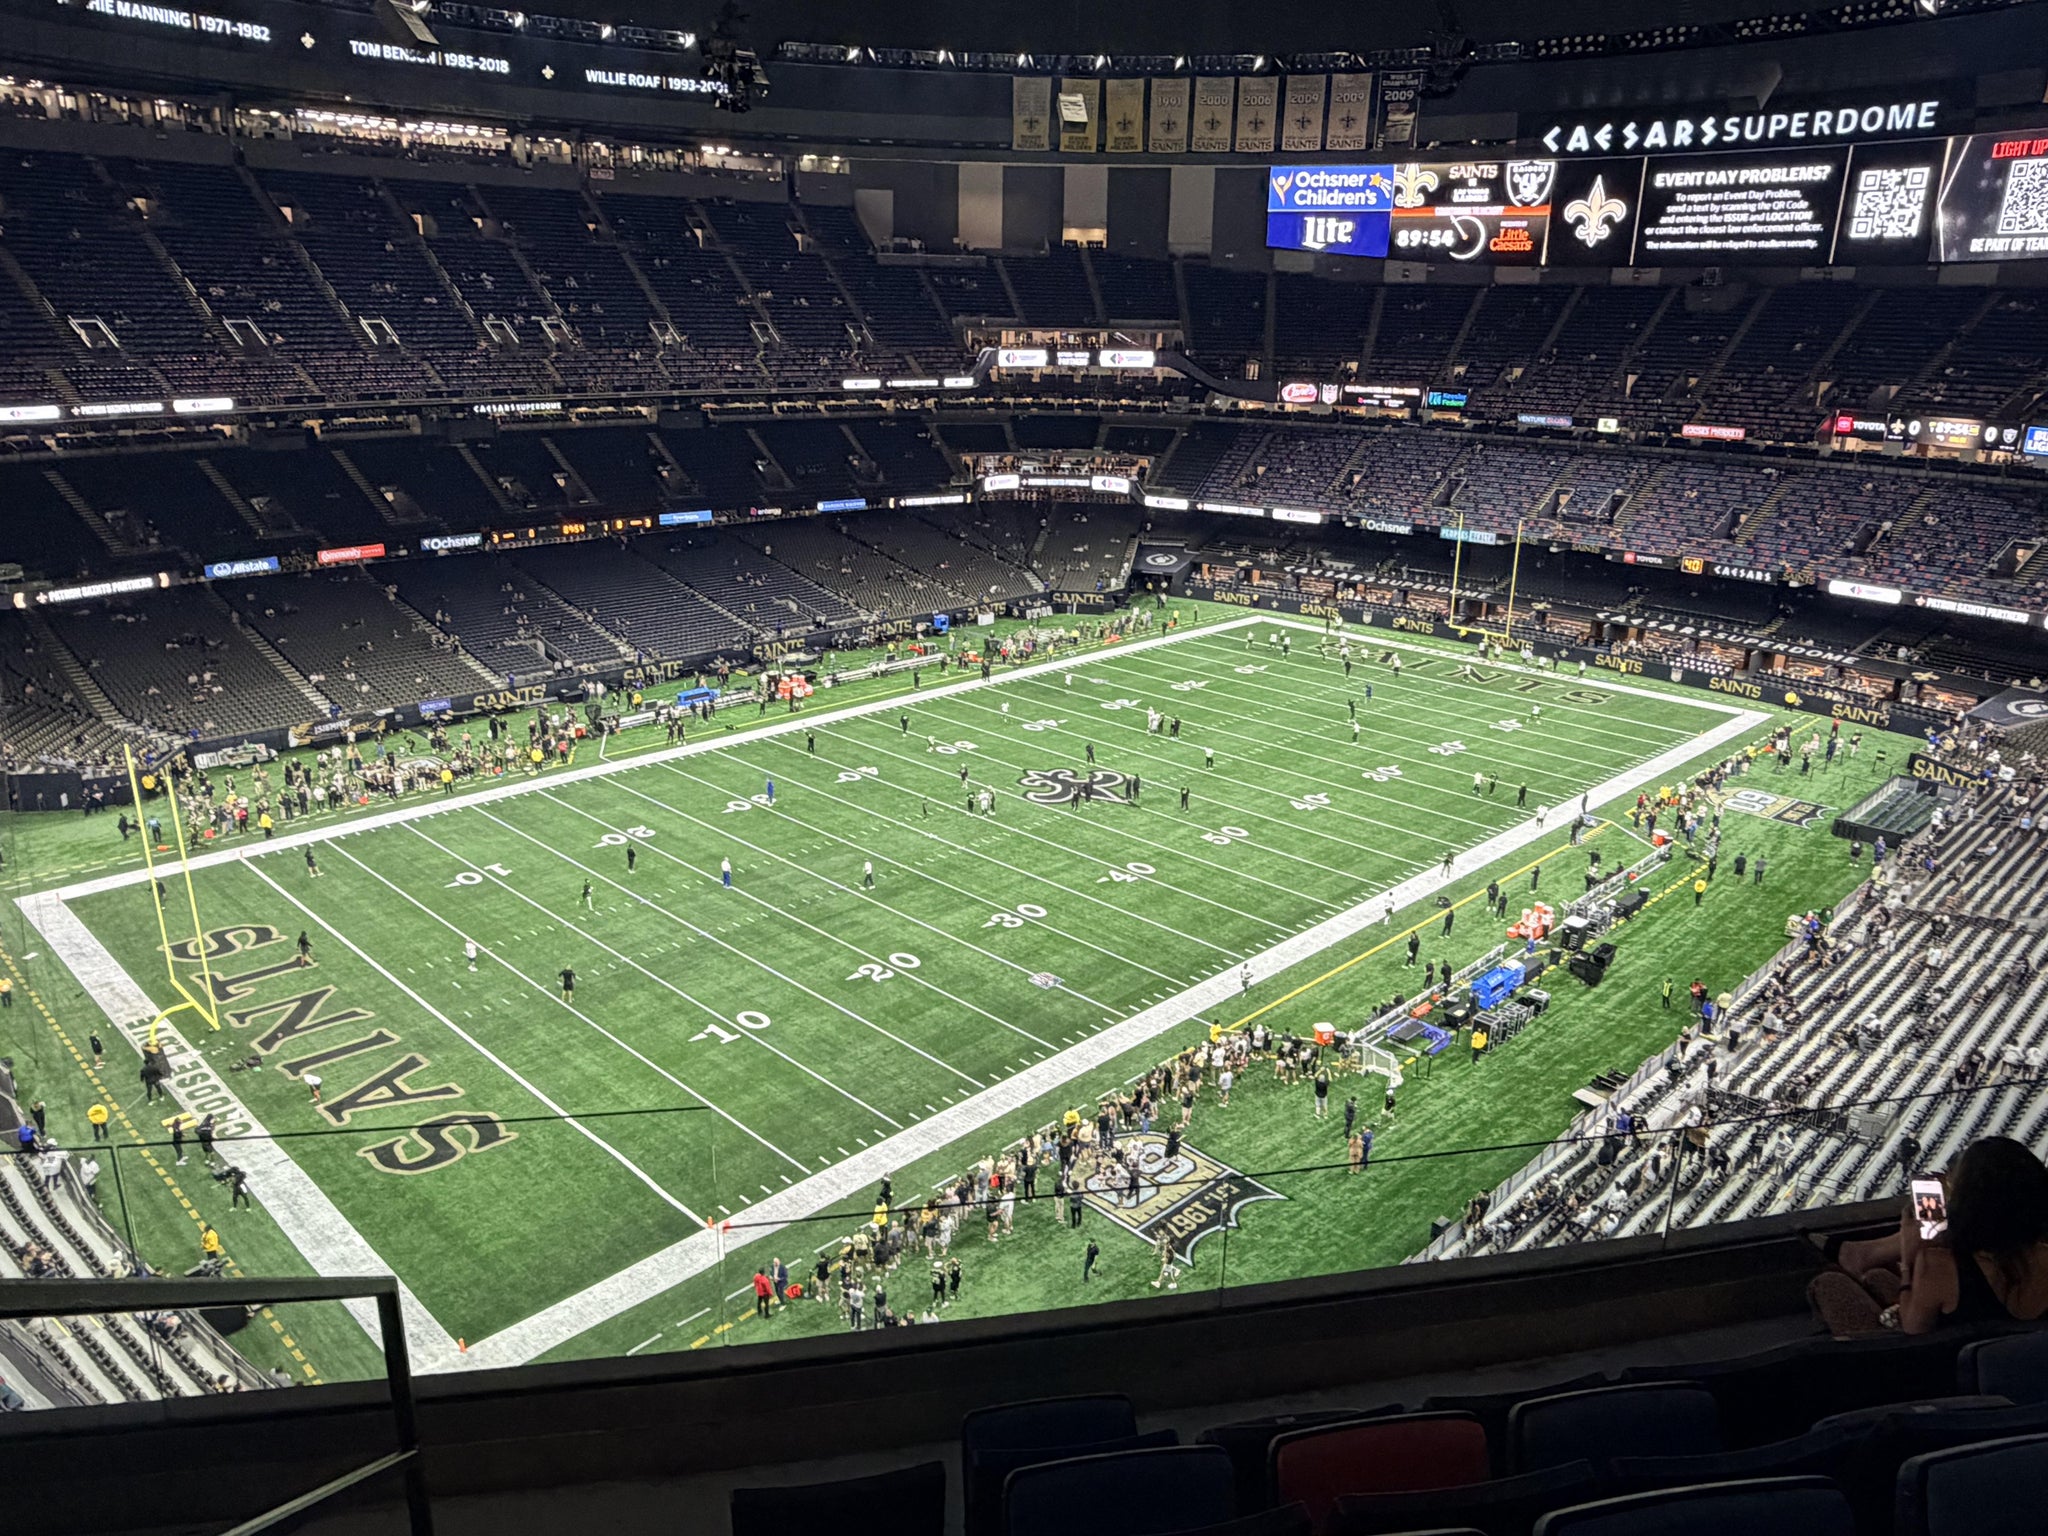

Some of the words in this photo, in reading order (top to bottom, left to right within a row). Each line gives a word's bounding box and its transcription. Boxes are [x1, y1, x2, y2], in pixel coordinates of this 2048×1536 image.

[117, 1, 191, 27] MANNING
[199, 15, 271, 41] 1971-1982
[349, 40, 381, 58] TOM
[445, 53, 510, 74] 1985-2018
[585, 70, 627, 85] WILLIE
[628, 74, 661, 88] ROAF
[1200, 96, 1228, 106] 2000
[1244, 95, 1272, 106] 2006
[1384, 90, 1414, 101] 2009
[1543, 115, 1718, 153] CAESARS
[1722, 100, 1940, 141] SUPERDOME
[1151, 142, 1184, 151] SAINTS
[1194, 142, 1229, 151] SAINTS
[1238, 141, 1271, 151] SAINTS
[1285, 140, 1318, 149] SAINTS
[1329, 139, 1363, 148] SAINTS
[1992, 140, 2032, 158] LIGHT
[1295, 171, 1367, 189] Ochsner
[1449, 165, 1498, 179] SAINTS
[1655, 172, 1705, 188] EVENT
[1705, 170, 1738, 185] DAY
[1739, 165, 1832, 185] PROBLEMS?
[1293, 188, 1377, 206] Children's
[1675, 193, 1686, 202] To
[1687, 193, 1712, 203] report
[1724, 191, 1748, 200] Event
[1749, 191, 1764, 201] Day
[1667, 204, 1686, 213] send
[1693, 204, 1709, 212] text
[1710, 203, 1720, 213] by
[1721, 202, 1756, 212] scanning
[1757, 202, 1771, 210] the
[1772, 201, 1785, 210] QR
[1786, 201, 1809, 209] Code
[1660, 215, 1675, 224] and
[1676, 214, 1708, 224] entering
[1709, 214, 1723, 223] the
[1724, 213, 1749, 222] ISSUE
[1750, 212, 1765, 221] and
[1766, 211, 1813, 221] LOCATION
[1301, 216, 1353, 249] Lite
[1396, 229, 1454, 247] 89:54
[1500, 228, 1529, 241] Little
[1655, 226, 1684, 235] contact
[1685, 226, 1698, 234] the
[1700, 225, 1726, 234] closest
[1727, 225, 1741, 233] law
[1742, 224, 1793, 233] enforcement
[1489, 237, 1533, 252] Caesars
[1970, 238, 1985, 252] BE
[1985, 238, 2011, 252] PART
[2011, 237, 2026, 251] OF
[473, 403, 515, 413] CAESARS
[515, 402, 561, 411] SUPERDOME
[1518, 415, 1546, 423] VENTURE
[1854, 422, 1885, 431] TOYOTA
[1909, 420, 1921, 436] 0
[1984, 427, 1998, 442] 0
[1367, 520, 1411, 535] Ochsner
[430, 535, 481, 550] Ochsner
[1470, 531, 1496, 545] HEALTH
[231, 561, 270, 574] Allstate
[1637, 555, 1663, 565] TOYOTA
[1683, 560, 1700, 572] 40
[1714, 565, 1771, 582] CAESARS
[49, 589, 81, 602] PATRON
[82, 584, 111, 597] SAINTS
[112, 577, 153, 594] PARTNERS
[1378, 577, 1491, 600] SUPERDOME
[1053, 592, 1104, 605] SAINTS
[1214, 590, 1250, 605] SAINTS
[1300, 604, 1340, 618] SAINTS
[754, 638, 805, 658] SAINTS
[1490, 636, 1534, 651] SAINTS
[1714, 631, 1860, 665] SUPERDOME
[624, 660, 683, 680] SAINTS
[1595, 653, 1643, 673] SAINTS
[473, 684, 547, 708] SAINTS
[1708, 677, 1762, 699] SAINTS
[1832, 703, 1890, 727] SAINTS
[840, 766, 880, 783] 40
[1361, 764, 1403, 782] 30
[1291, 791, 1331, 812] 40
[598, 825, 656, 847] 20
[1201, 825, 1250, 846] 50
[455, 863, 513, 886] 10
[1112, 862, 1156, 884] 40
[994, 903, 1048, 929] 30
[863, 952, 921, 982] 20
[700, 1011, 771, 1045] 10
[157, 922, 520, 1176] SAINTS
[1169, 1201, 1217, 1240] 1967
